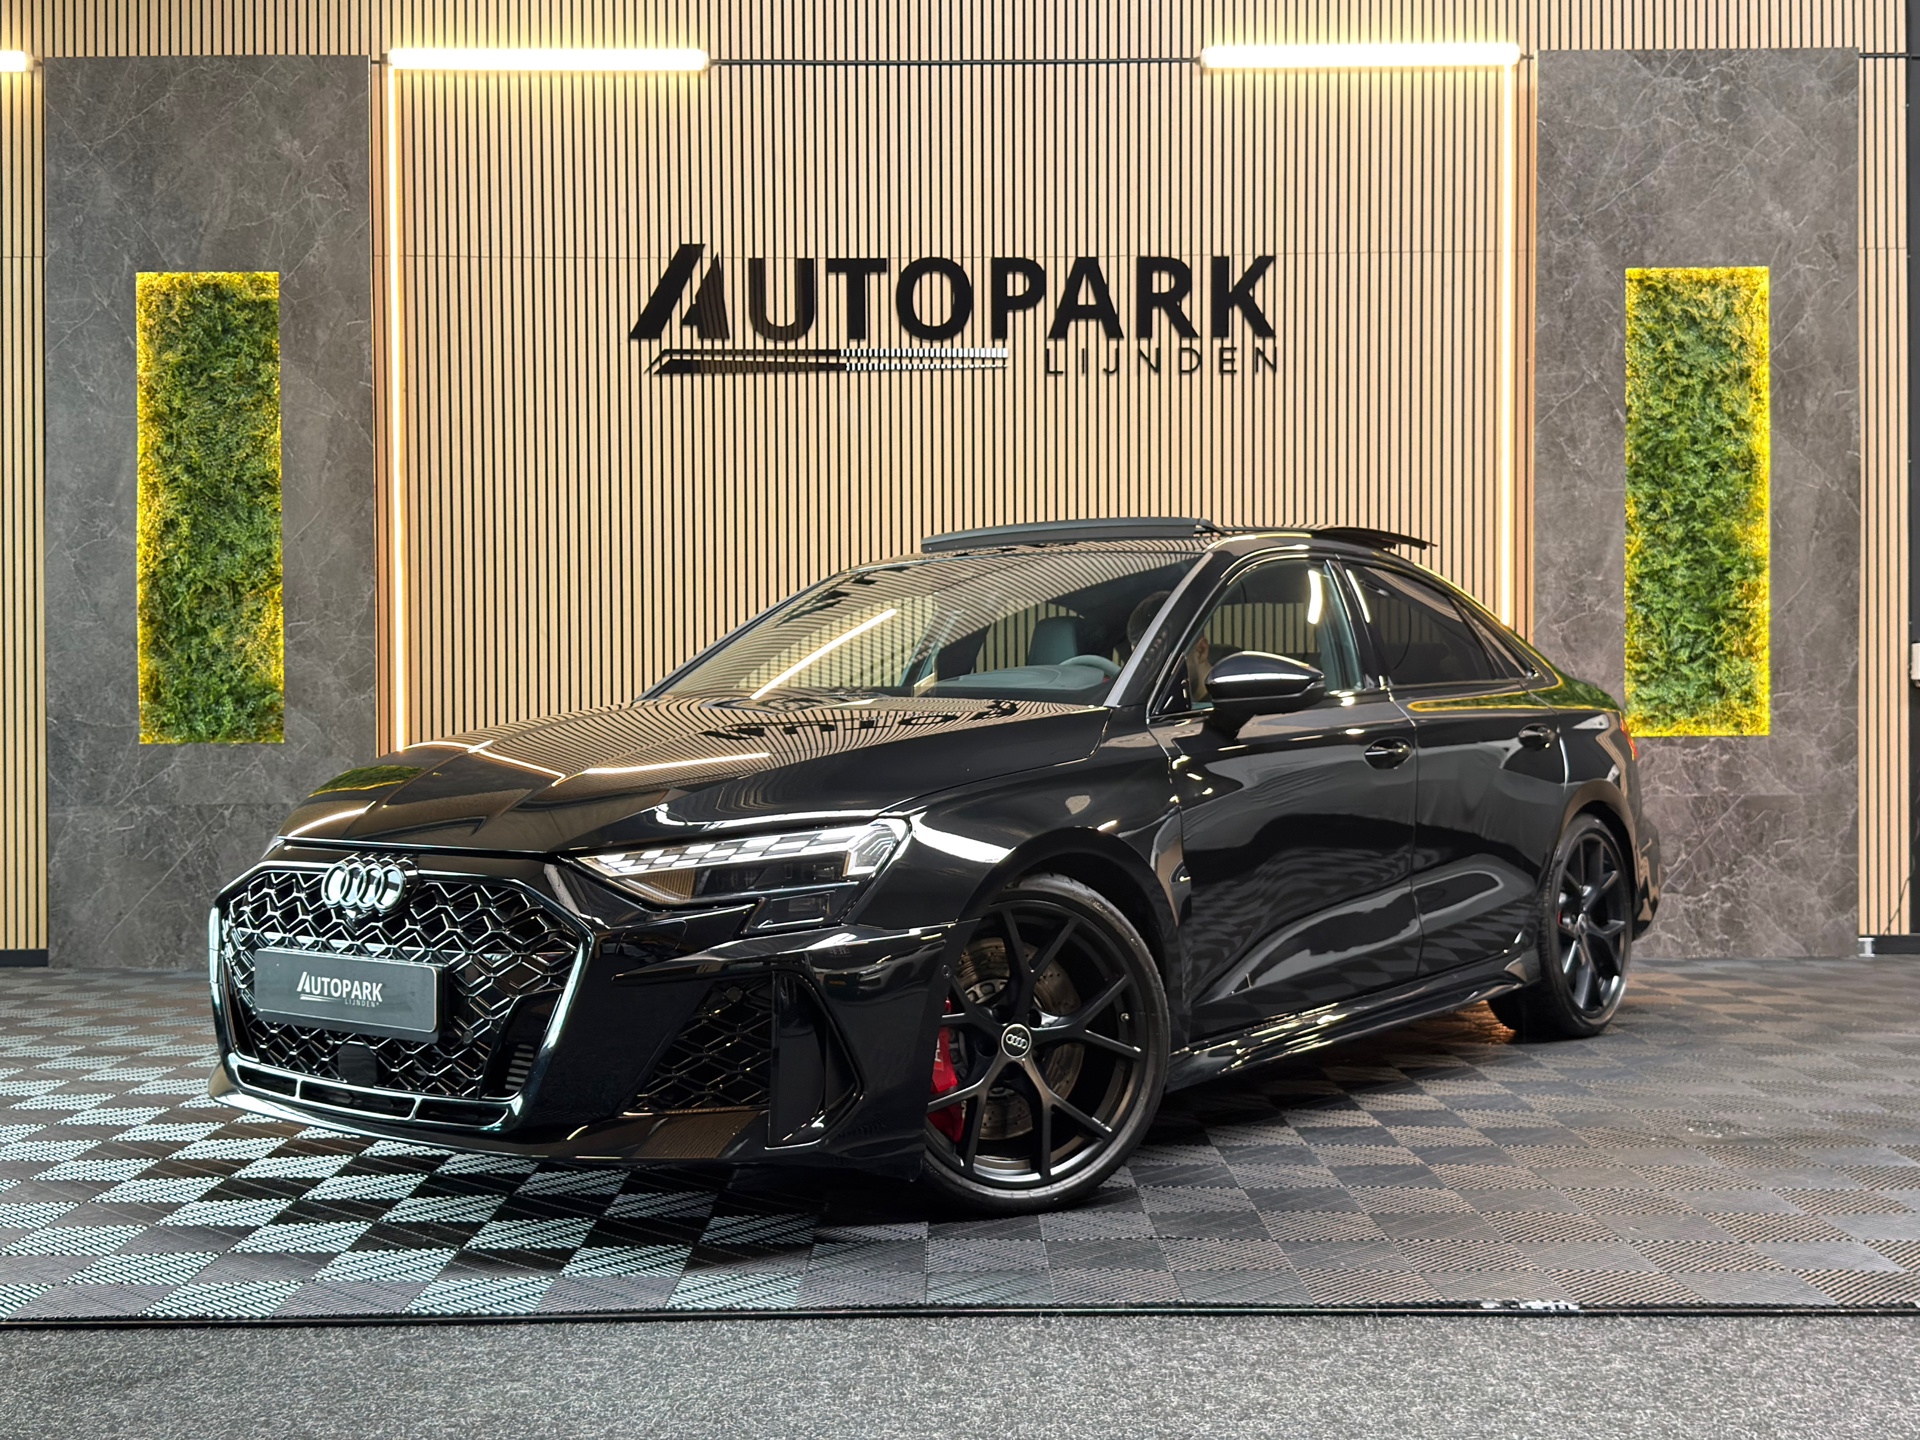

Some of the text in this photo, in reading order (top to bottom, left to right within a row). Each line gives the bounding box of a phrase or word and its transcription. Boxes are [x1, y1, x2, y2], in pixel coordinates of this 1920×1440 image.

[629, 243, 1277, 341] AUTOPARK
[1046, 347, 1277, 375] LIJNDEN
[296, 971, 383, 1003] AUTOPARK
